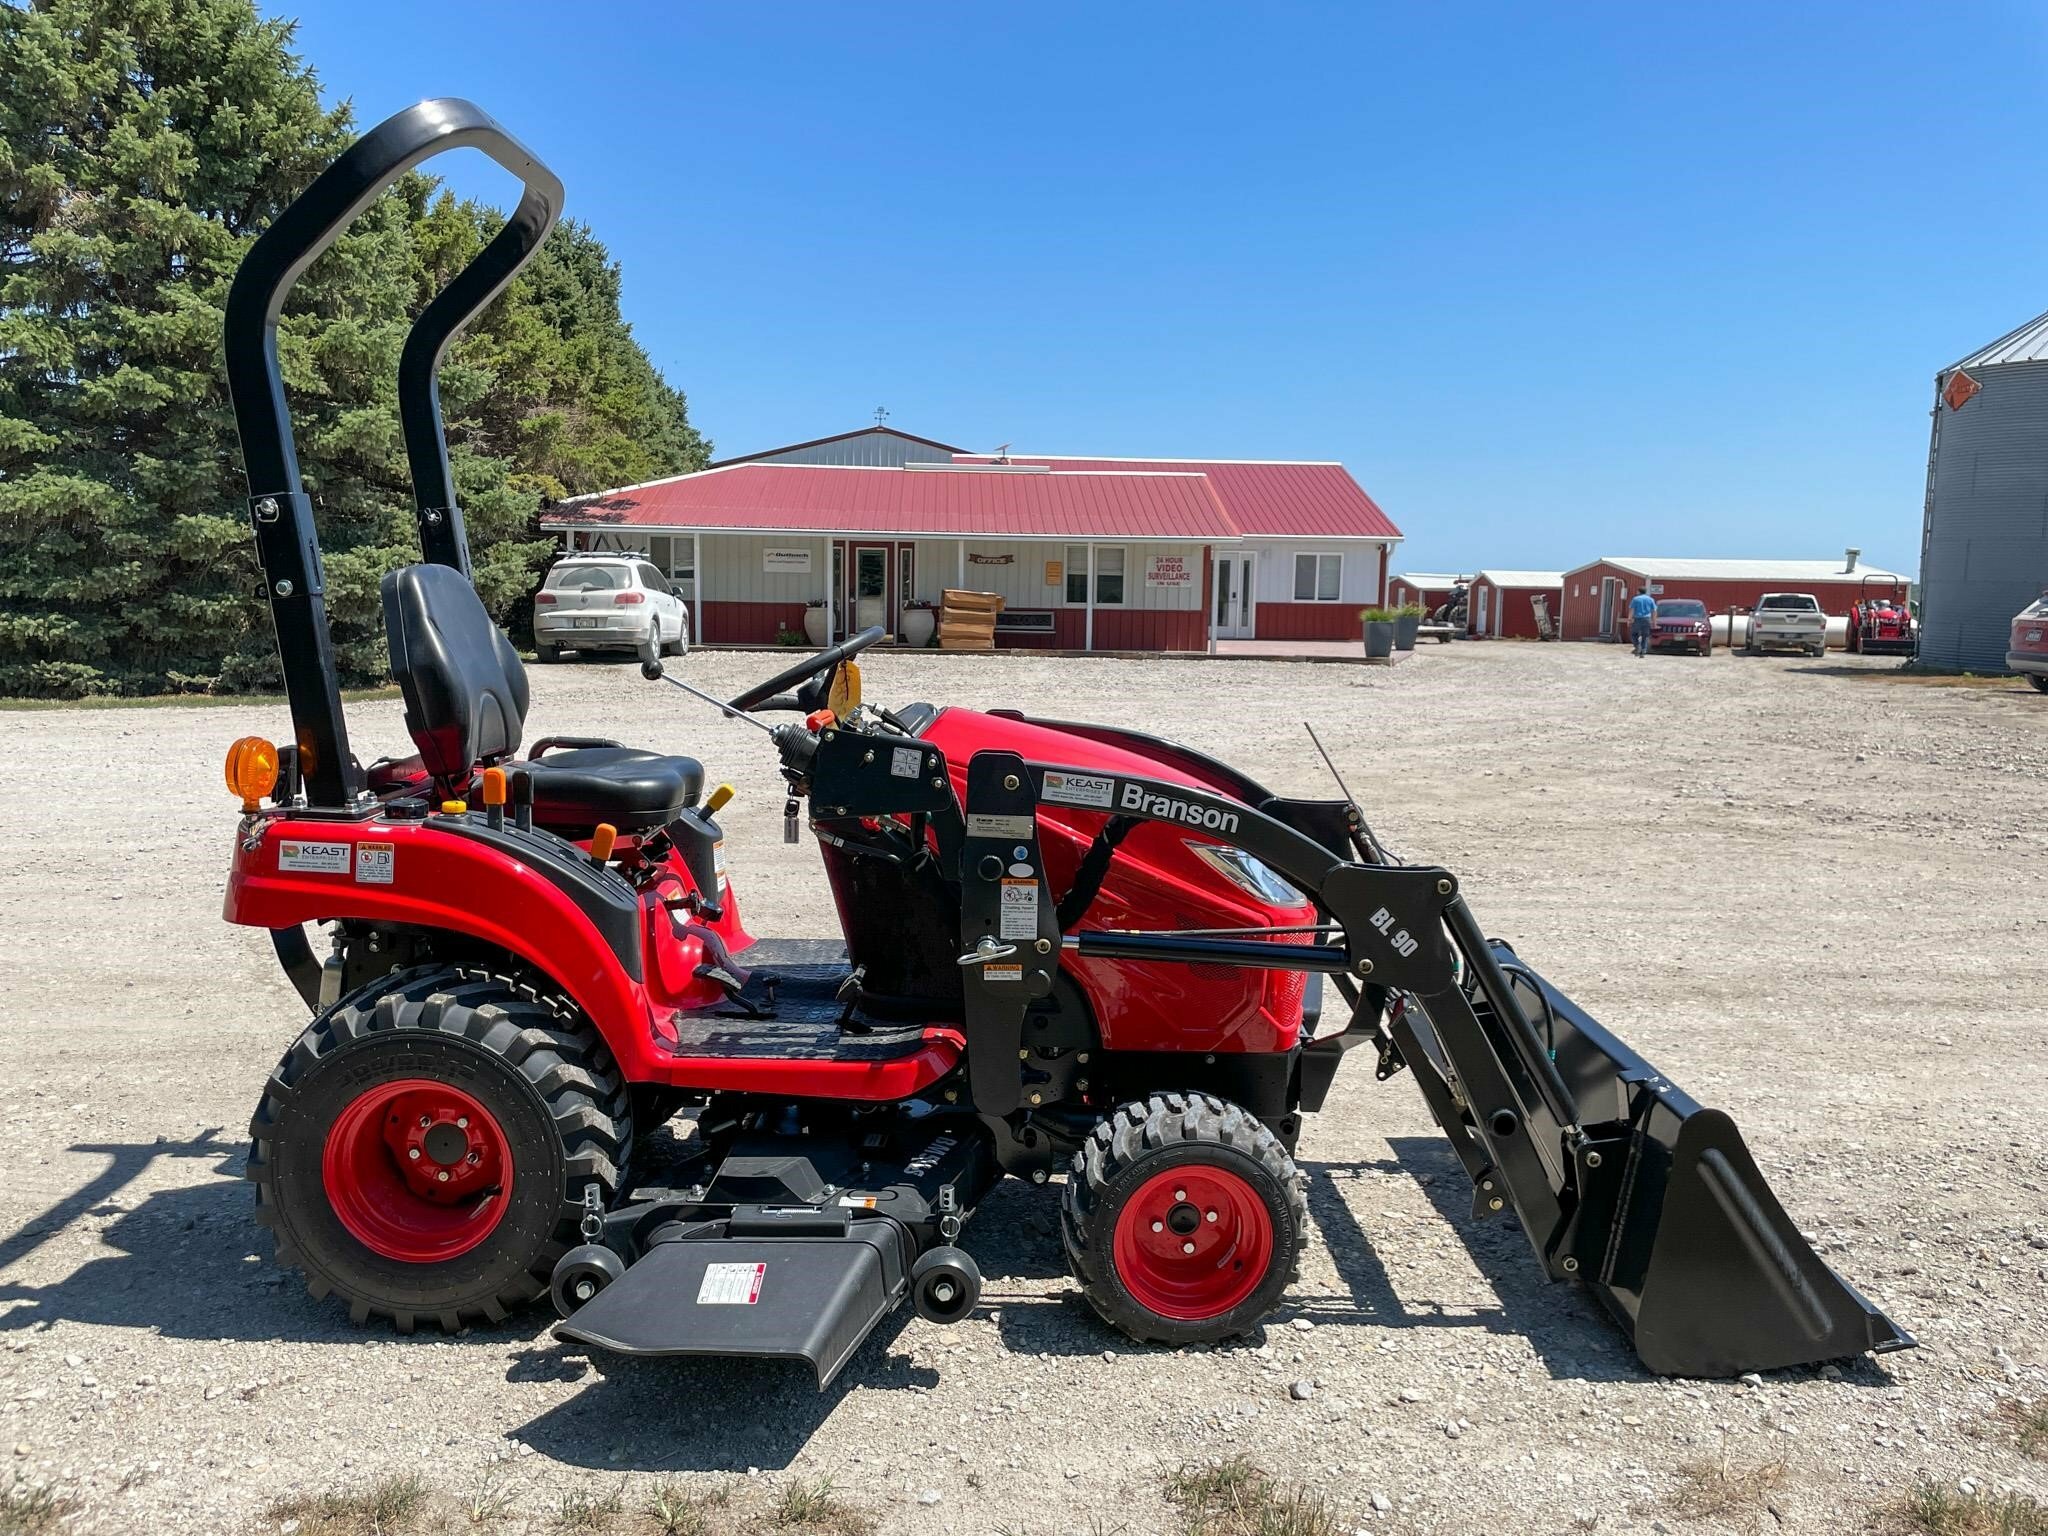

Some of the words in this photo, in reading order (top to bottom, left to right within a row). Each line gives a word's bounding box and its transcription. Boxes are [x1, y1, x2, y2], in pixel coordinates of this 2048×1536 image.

[1156, 556, 1164, 564] 24
[1156, 564, 1183, 572] VIDEO
[1148, 572, 1191, 581] SURVEILLANCE
[1066, 777, 1112, 791] KEAST
[1065, 786, 1101, 795] ENTERPRISES
[1120, 782, 1239, 834] Branson
[302, 846, 349, 856] KEAST
[1369, 907, 1396, 936] BL
[1391, 930, 1418, 957] 90
